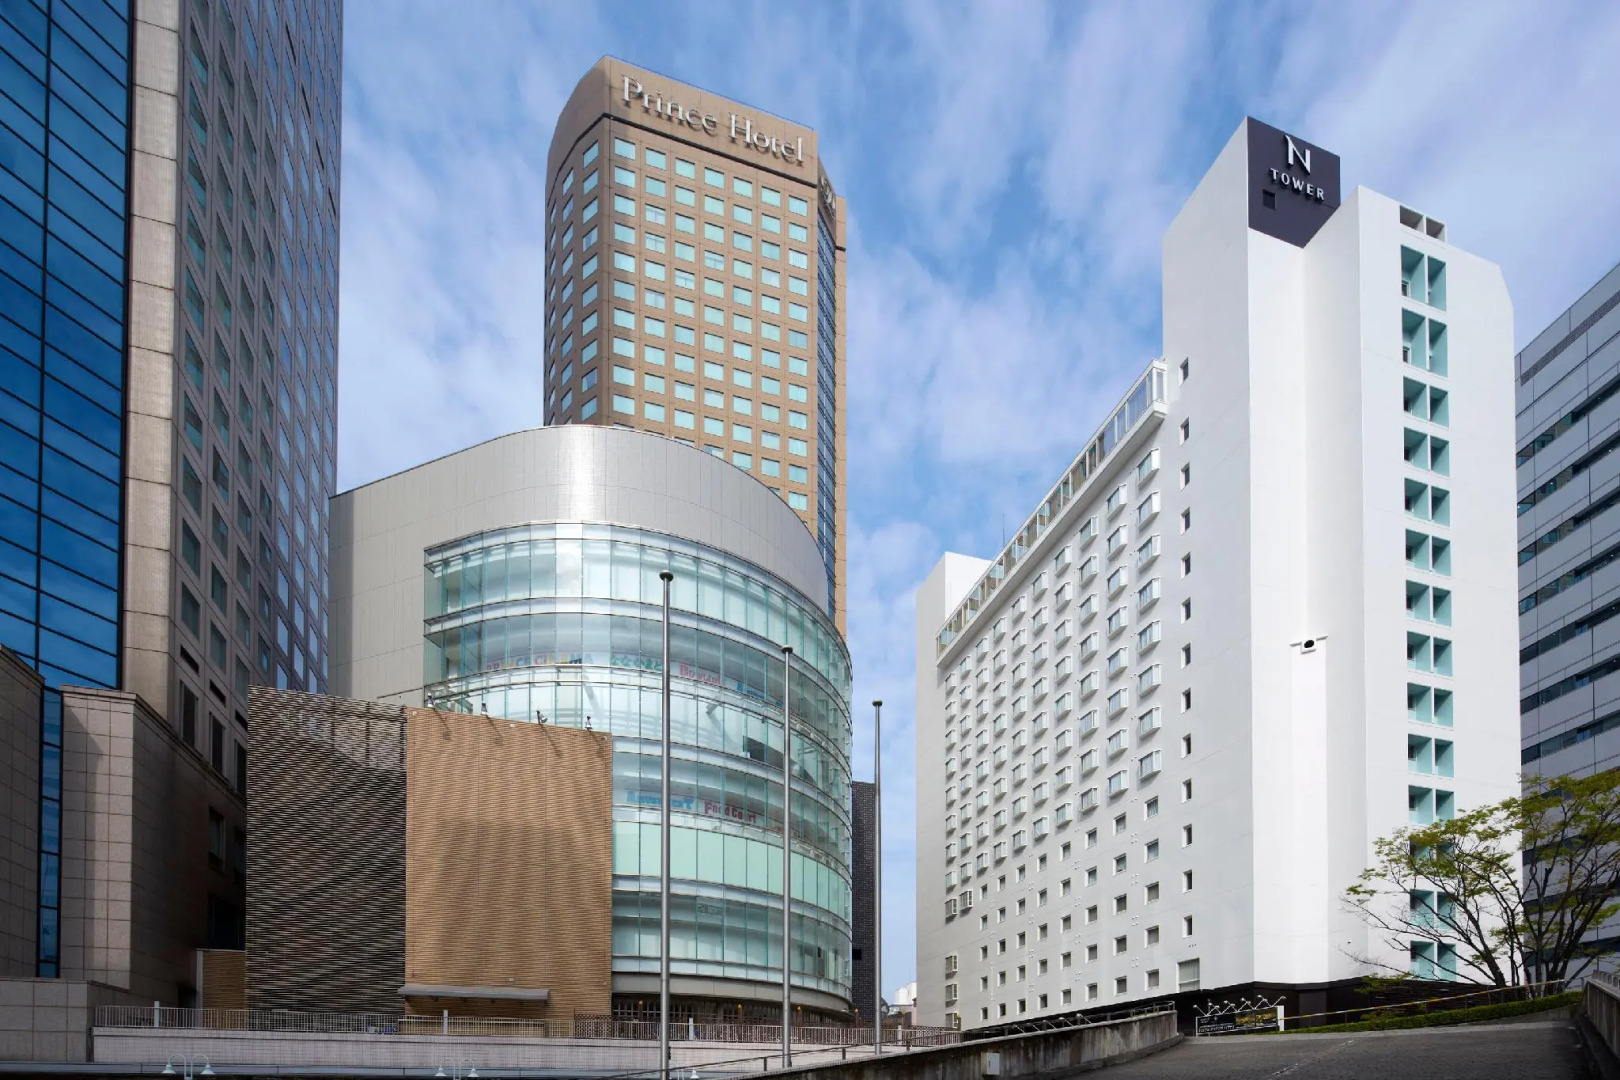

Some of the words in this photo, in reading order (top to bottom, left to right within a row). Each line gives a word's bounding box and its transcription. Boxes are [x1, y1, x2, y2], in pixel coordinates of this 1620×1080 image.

[621, 74, 717, 129] Prince
[728, 112, 804, 162] Hotel
[1285, 134, 1311, 173] N
[1270, 167, 1324, 200] TOWER
[732, 807, 757, 823] Cort
